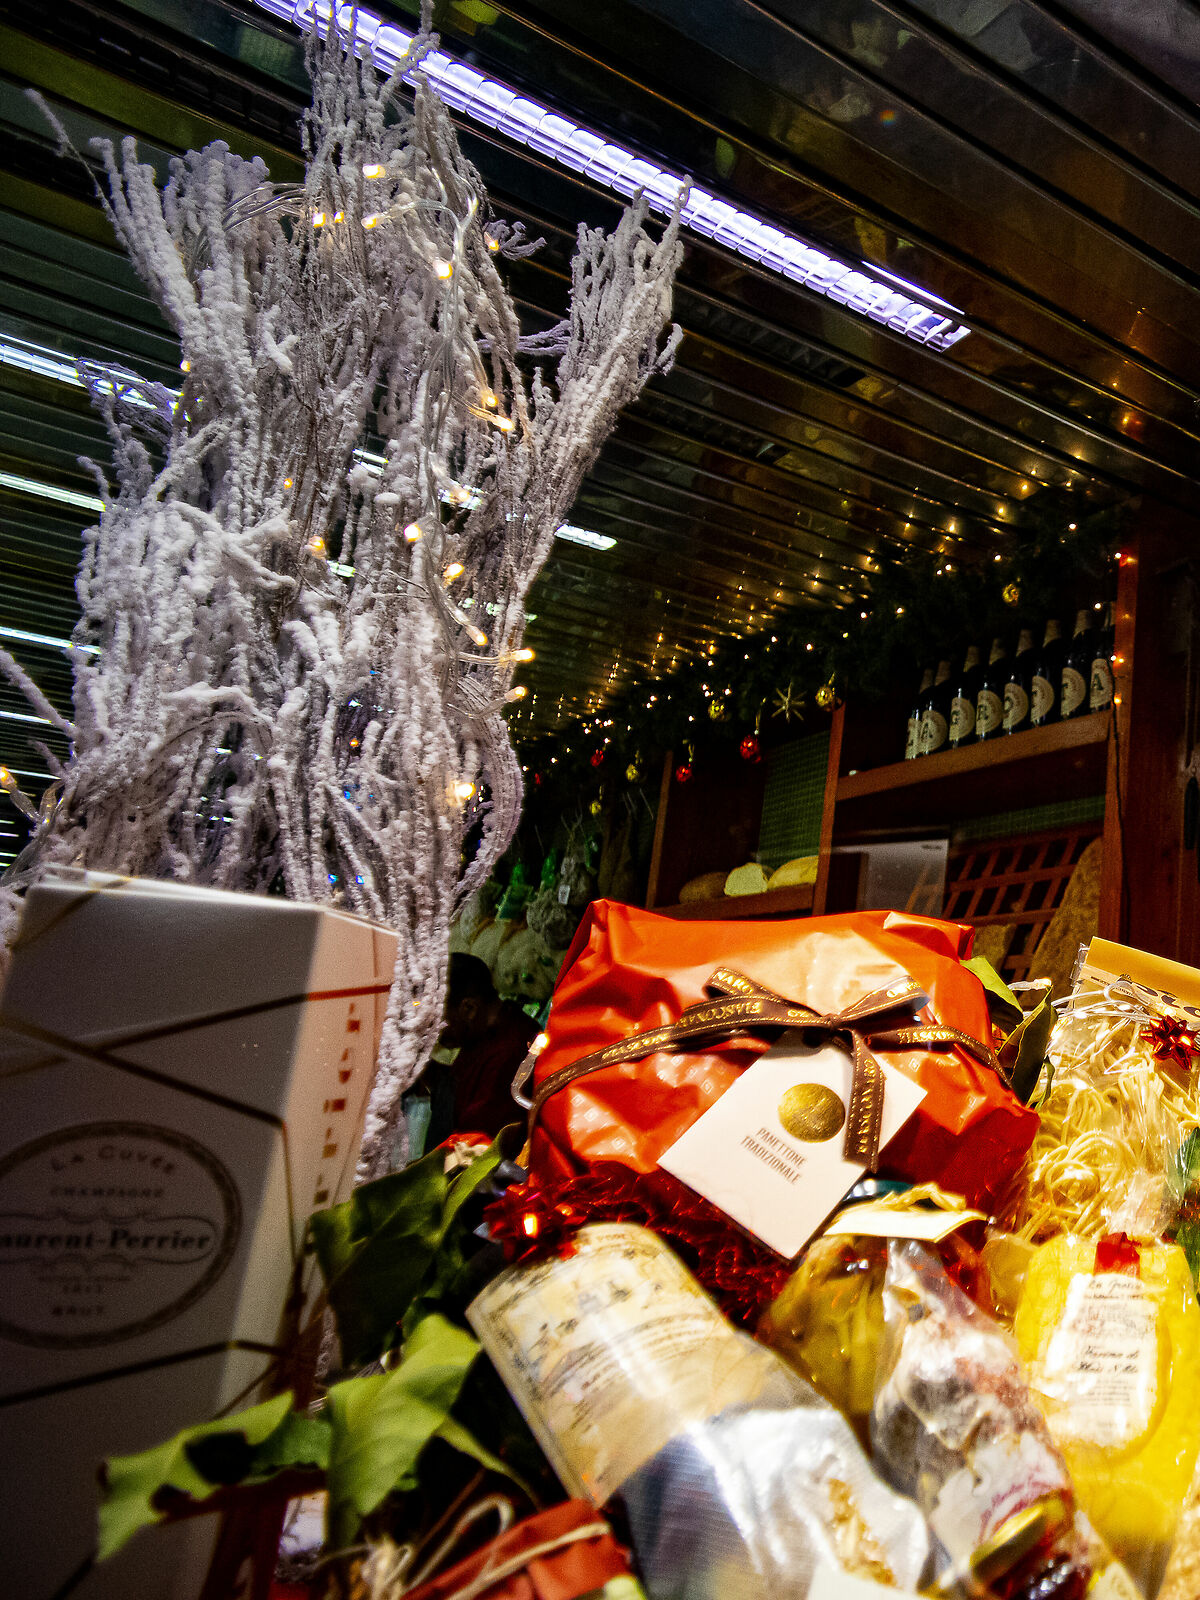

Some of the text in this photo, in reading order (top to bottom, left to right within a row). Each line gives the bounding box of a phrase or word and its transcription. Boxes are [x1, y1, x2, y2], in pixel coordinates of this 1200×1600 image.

[755, 1127, 807, 1168] PANETTONE
[740, 1135, 801, 1184] TRADIZIONALE
[49, 1187, 165, 1198] CHAMPAGNE
[0, 1228, 211, 1250] aurent-Perrier
[51, 1305, 105, 1317] BRUT
